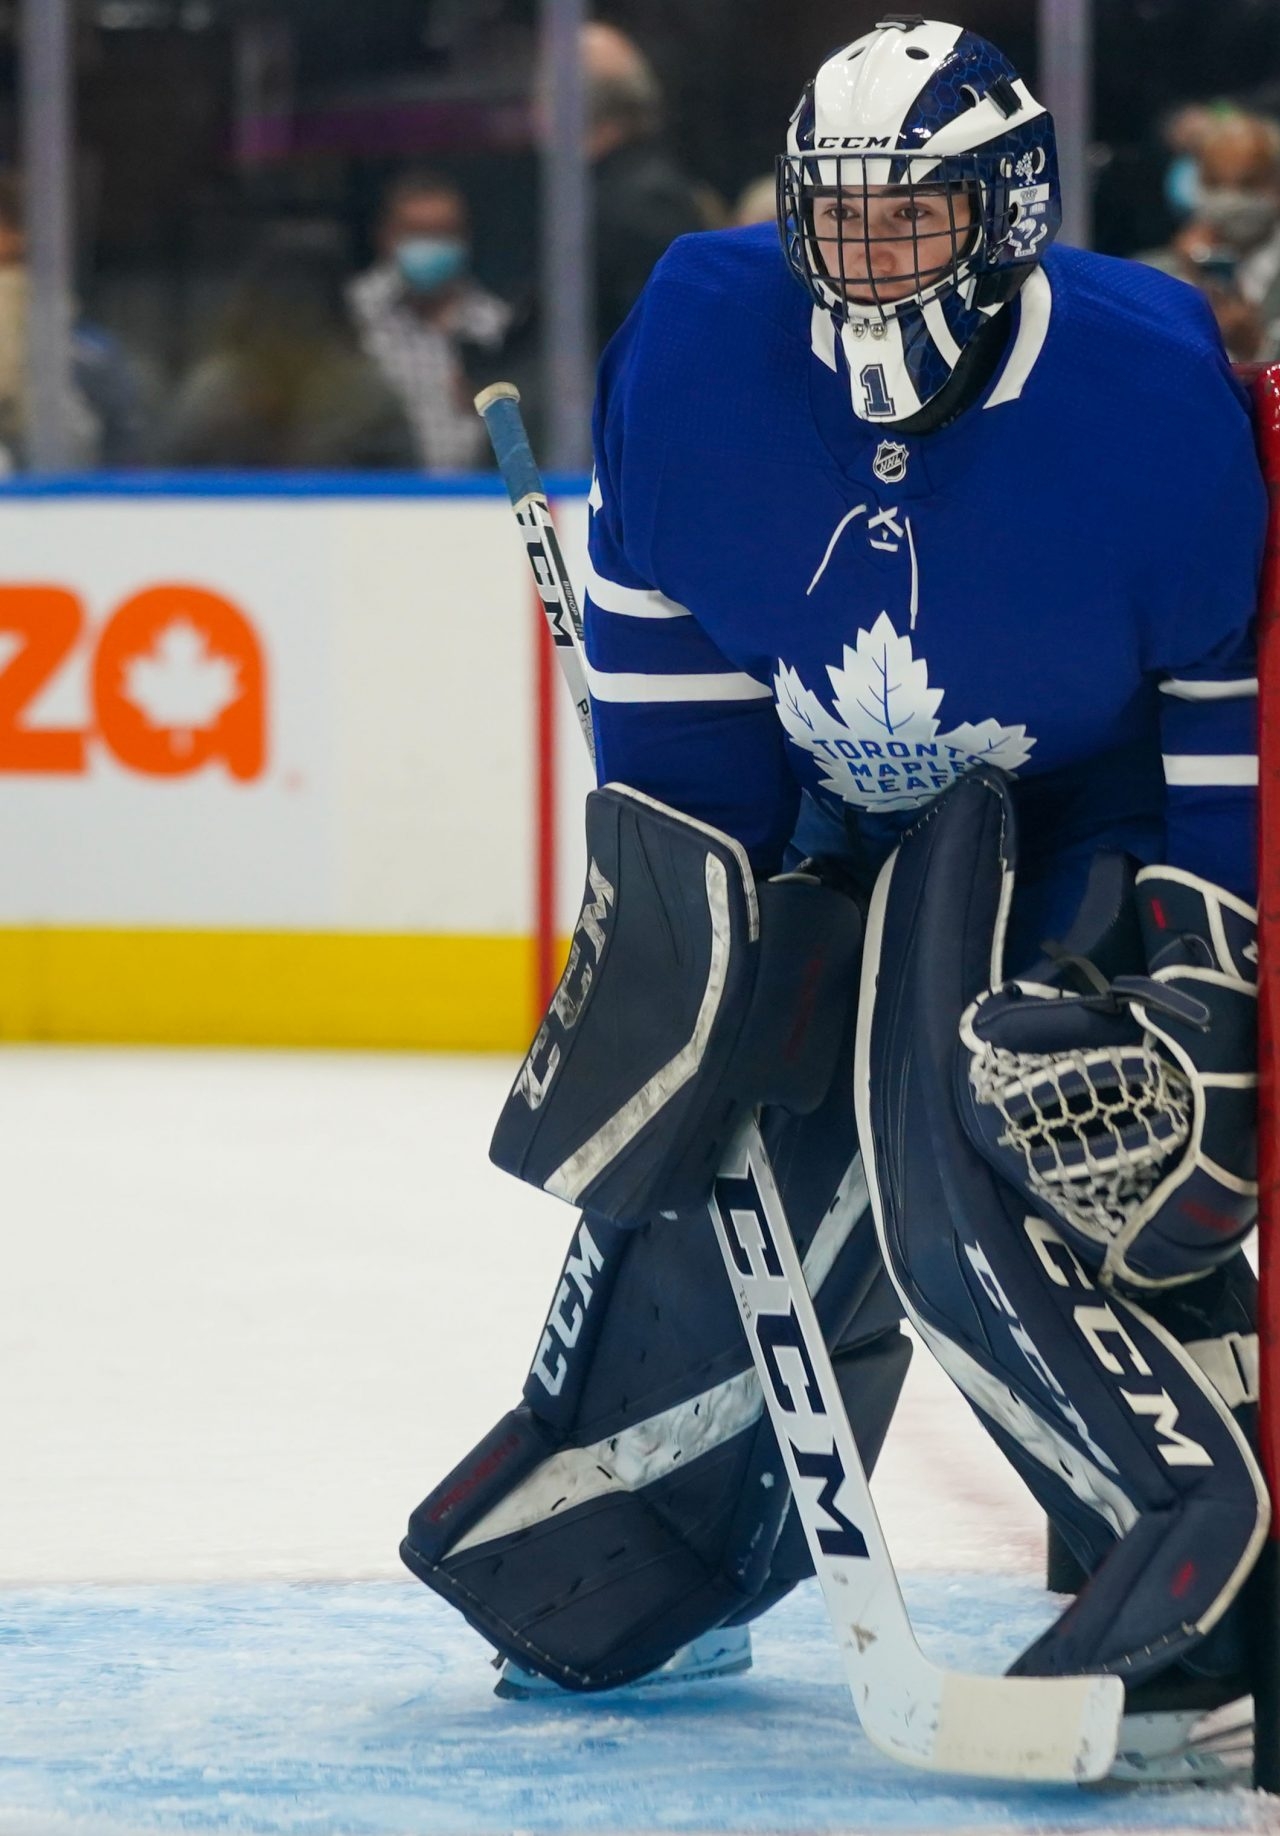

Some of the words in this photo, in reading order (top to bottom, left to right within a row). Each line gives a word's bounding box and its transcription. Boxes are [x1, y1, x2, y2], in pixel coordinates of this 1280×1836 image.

[818, 136, 892, 149] CCM
[859, 364, 894, 417] 1
[878, 454, 902, 471] NHL
[811, 739, 989, 768] TORONTO
[847, 759, 966, 778] MAPLE
[855, 775, 950, 794] LEAF
[513, 856, 615, 1111] CCM
[530, 1221, 604, 1396] CCM
[711, 1150, 870, 1559] CCM
[1023, 1216, 1215, 1467] CCM
